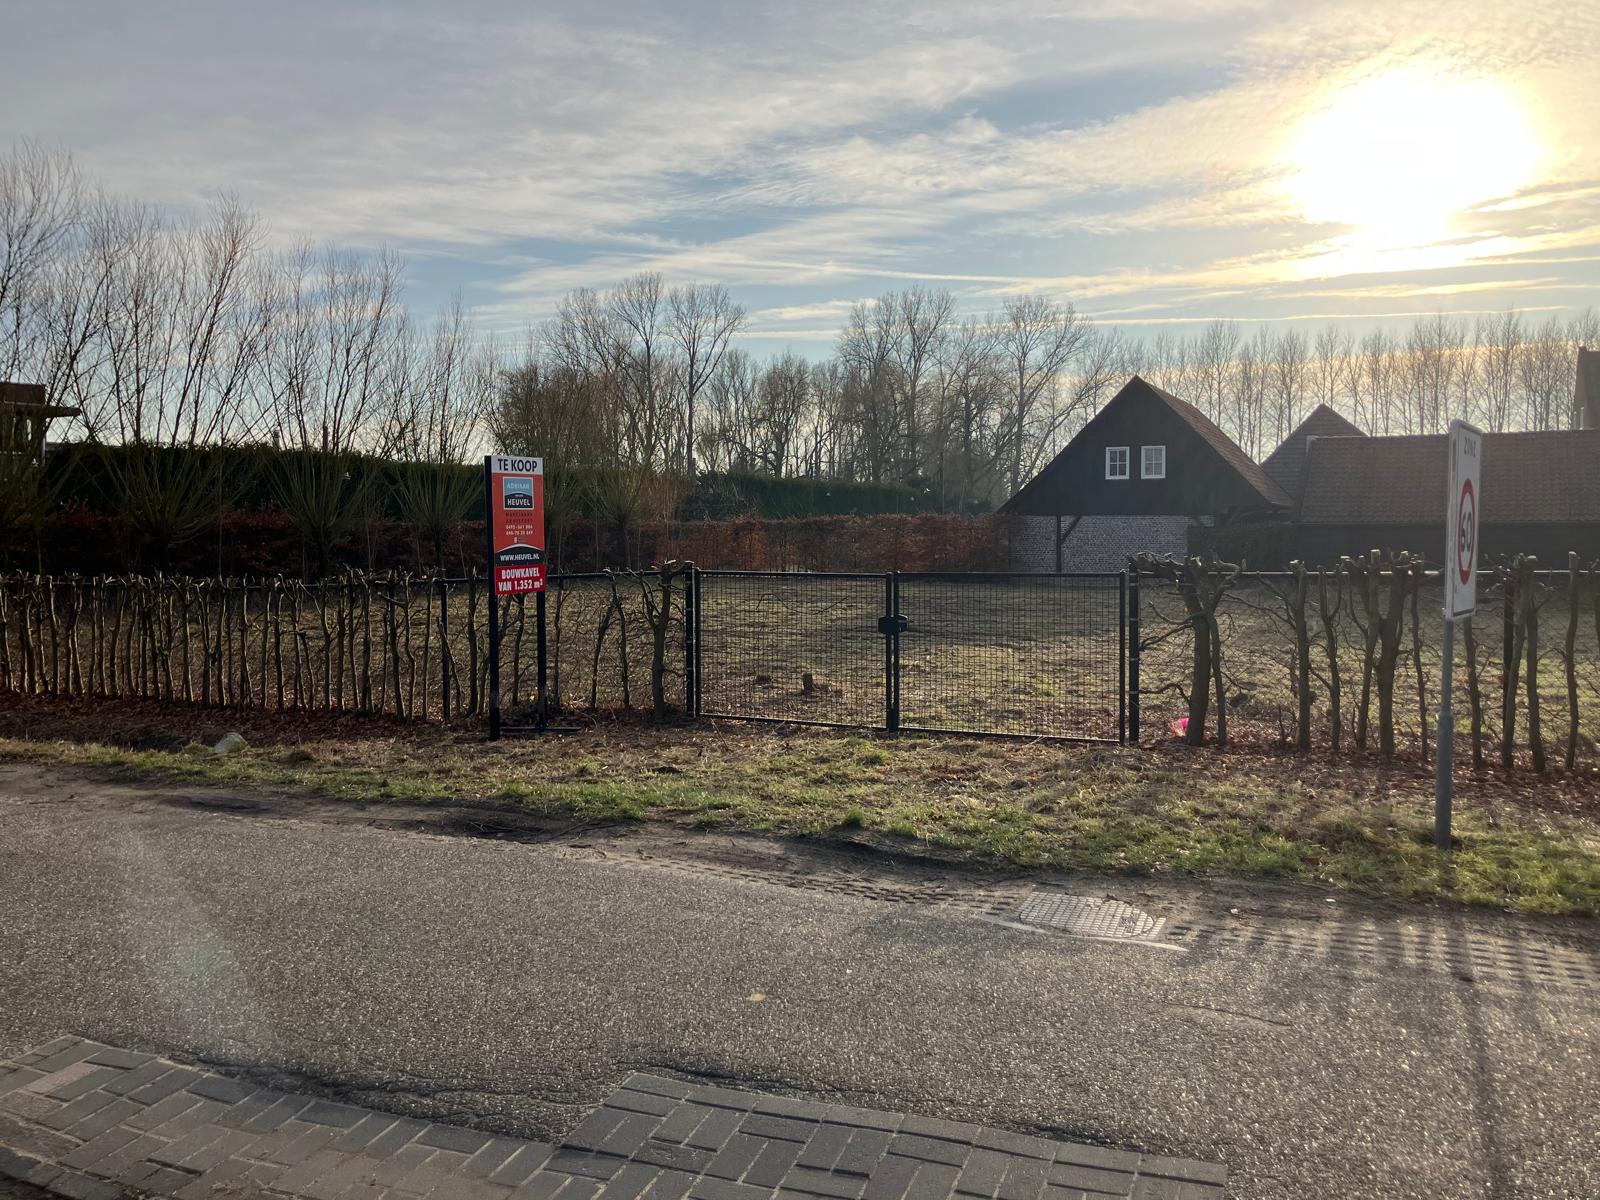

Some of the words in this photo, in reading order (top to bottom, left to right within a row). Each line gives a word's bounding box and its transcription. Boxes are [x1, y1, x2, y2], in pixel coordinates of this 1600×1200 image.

[497, 458, 509, 471] TE
[511, 459, 538, 472] KOOP
[507, 498, 531, 506] HEUVEL
[1460, 511, 1472, 553] 60
[500, 553, 540, 562] WWW.HEUVEL.NL
[501, 567, 540, 580] BOUWKAVEL
[498, 581, 512, 592] VAN
[514, 579, 533, 591] 1.352
